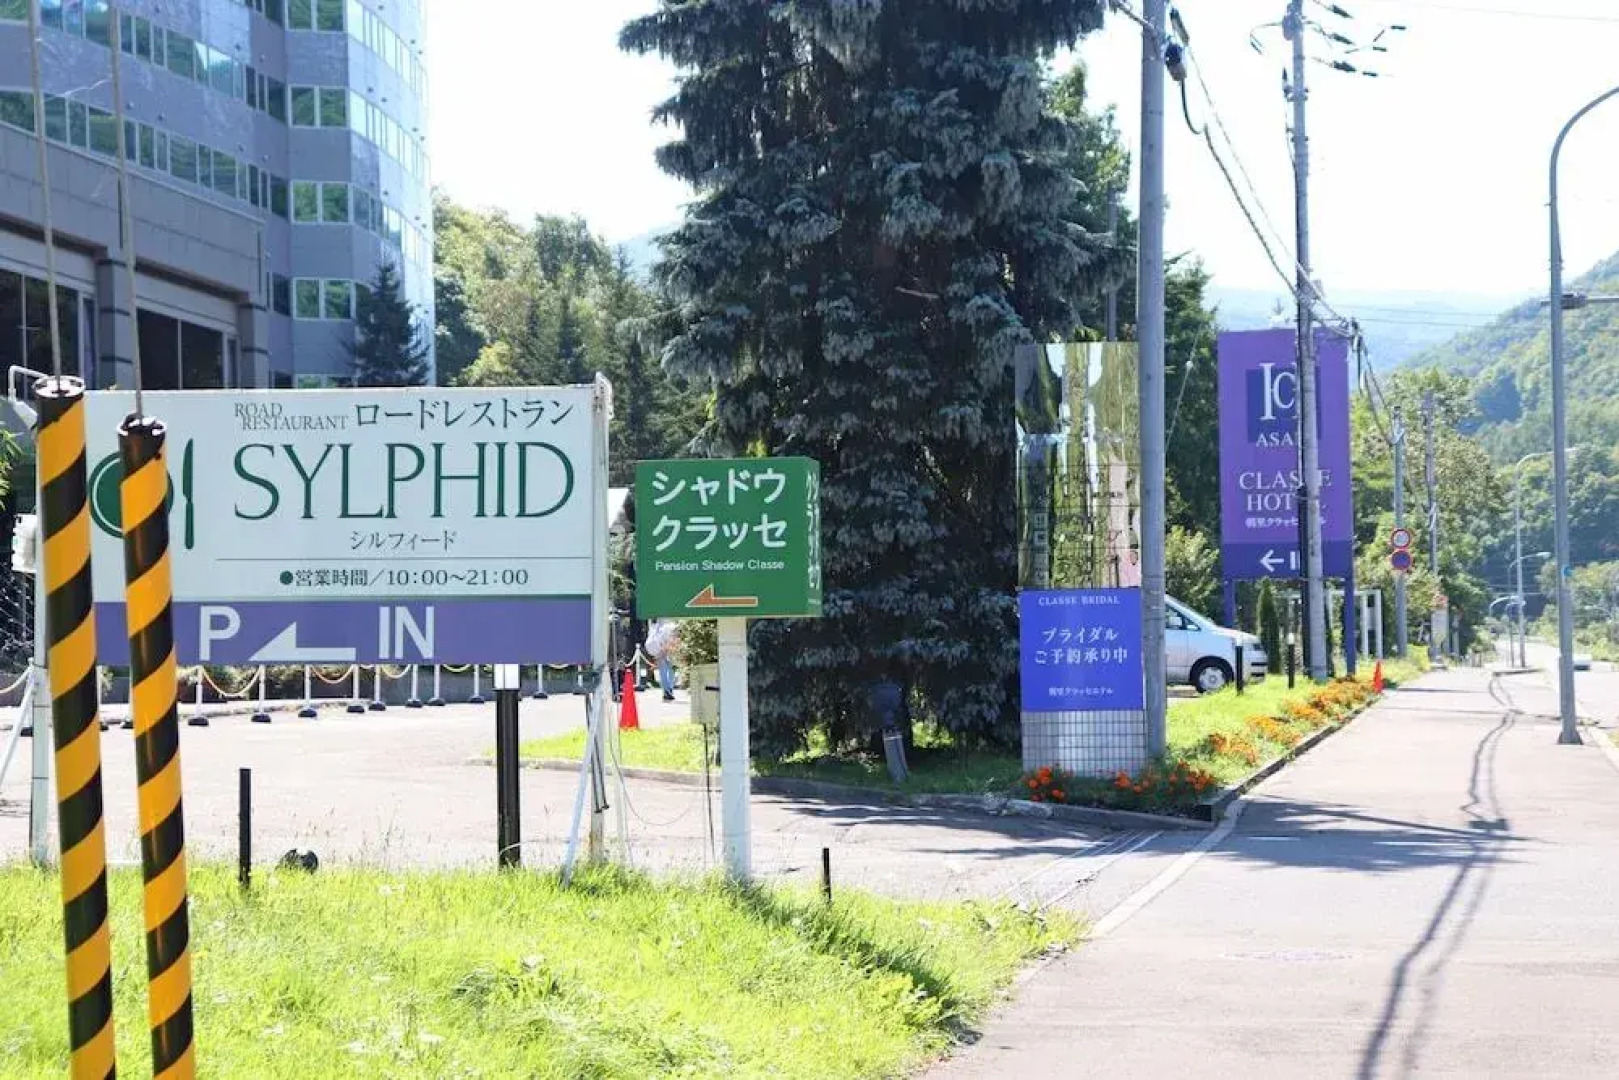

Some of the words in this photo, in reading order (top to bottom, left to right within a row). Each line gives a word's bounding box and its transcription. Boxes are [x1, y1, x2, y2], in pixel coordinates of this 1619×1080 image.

[234, 402, 282, 418] ROAD
[355, 399, 574, 430] ロードレストラン
[242, 415, 349, 430] RESTAURANT
[233, 441, 574, 520] SYLPHID
[652, 468, 786, 506] シャドウ
[1239, 470, 1332, 489] CLASE
[350, 530, 458, 551] シルフィード
[652, 513, 787, 552] クラッセ
[655, 560, 699, 571] Pension
[702, 559, 744, 571] Shadow
[747, 559, 785, 570] Classe
[201, 606, 242, 661] P
[378, 606, 435, 660] IN
[1035, 646, 1128, 665] ご予約承り中
